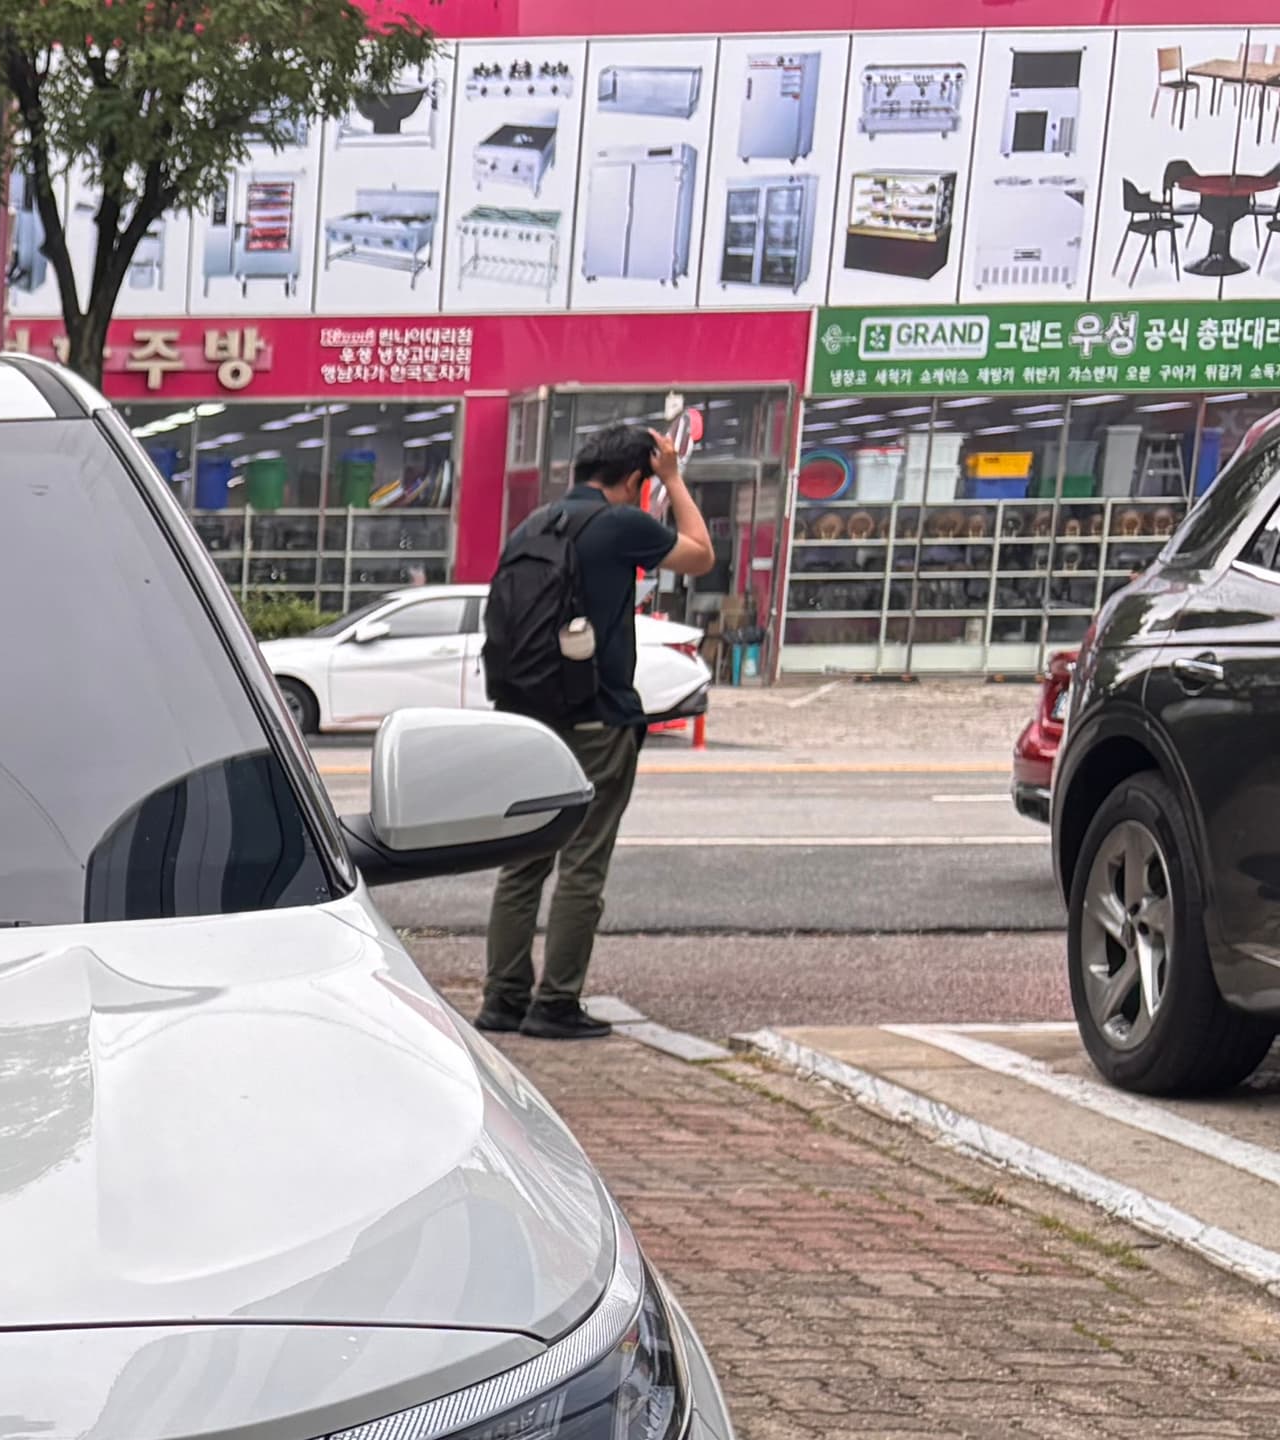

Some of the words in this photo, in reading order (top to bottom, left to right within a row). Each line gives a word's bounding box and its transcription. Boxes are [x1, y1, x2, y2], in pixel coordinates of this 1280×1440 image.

[379, 327, 473, 346] 린나이대리점
[896, 321, 984, 345] GRAND
[995, 319, 1063, 352] 그랜드
[1070, 312, 1139, 357] 우성
[1144, 318, 1189, 351] 공식
[830, 368, 868, 387] 냉장고
